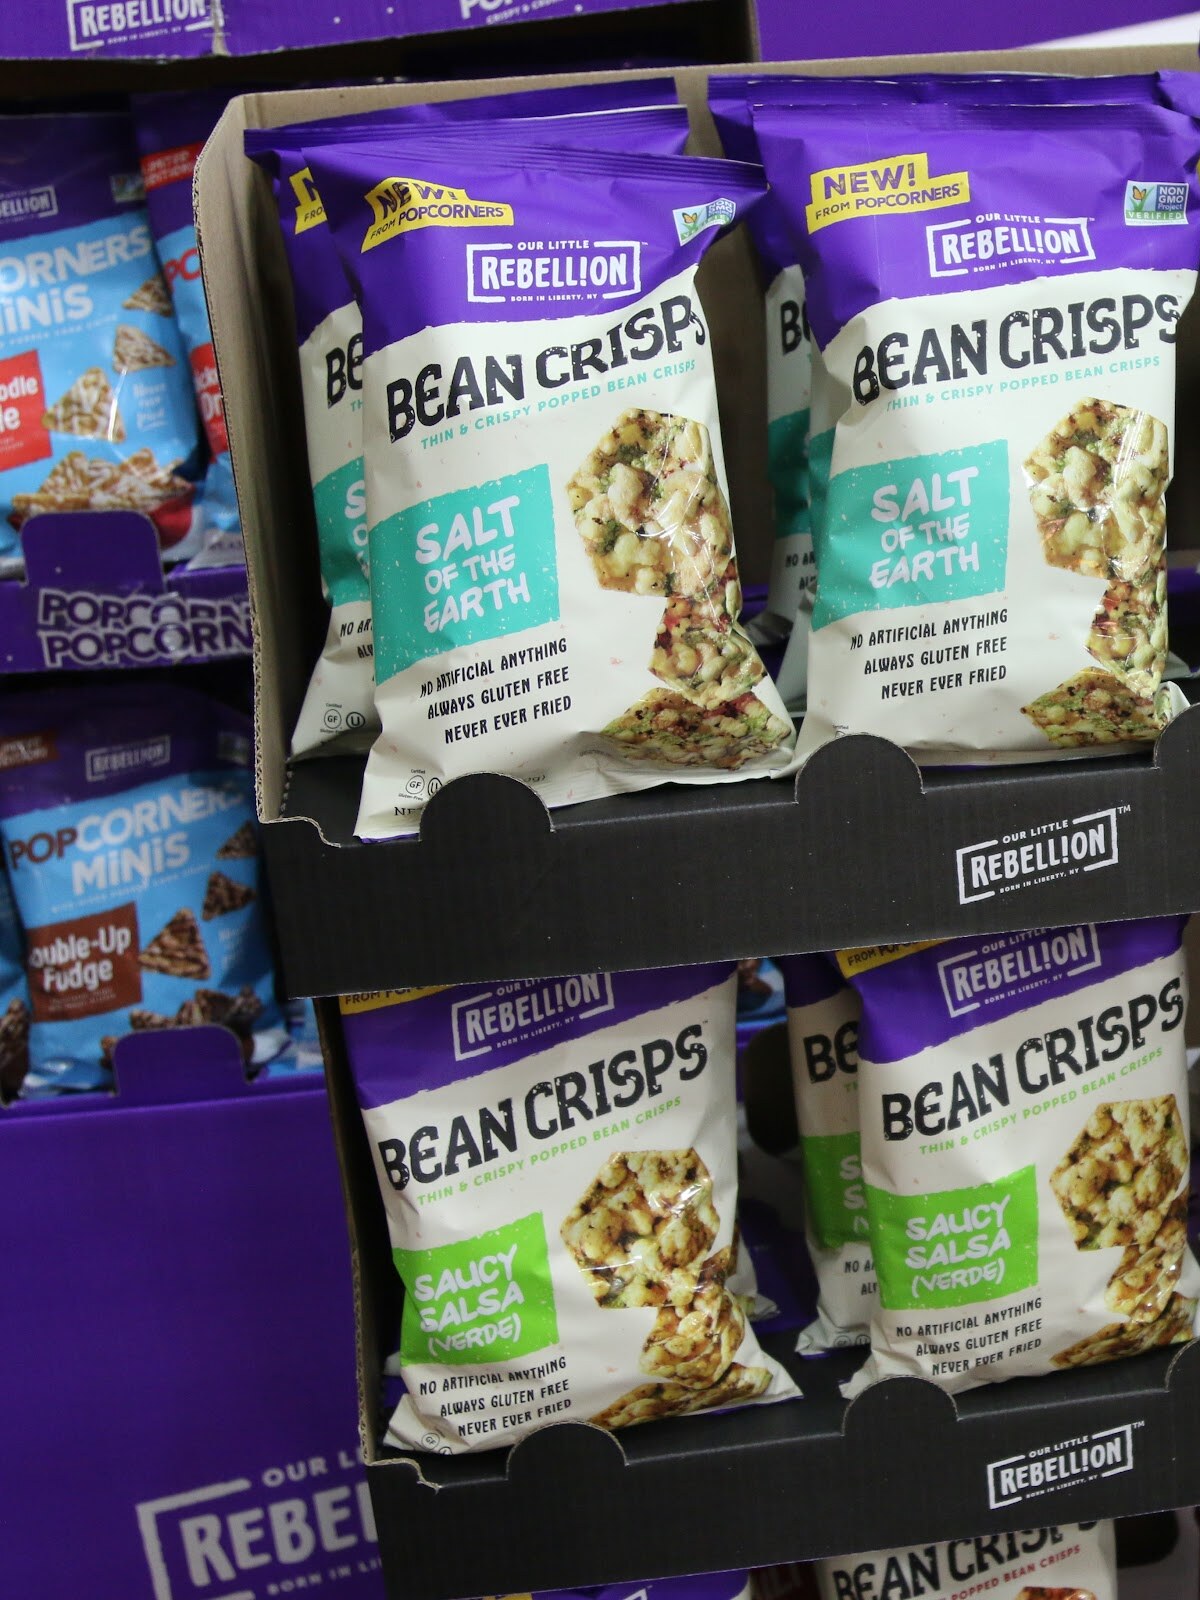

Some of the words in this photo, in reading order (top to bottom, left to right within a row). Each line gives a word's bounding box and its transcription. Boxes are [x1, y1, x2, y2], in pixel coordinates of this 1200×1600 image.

[376, 181, 457, 219] NEW!
[823, 163, 915, 199] NEW!
[1158, 187, 1185, 196] NON
[1158, 195, 1184, 204] GMO
[398, 202, 504, 226] POPCORNERS
[816, 202, 850, 220] FROM
[855, 184, 960, 210] POPCORNERS
[1128, 211, 1183, 220] VERIFIED
[1158, 203, 1182, 211] Project
[0, 227, 150, 289] ORNERS
[517, 241, 544, 250] OUR
[548, 240, 590, 250] LITTLE
[974, 264, 995, 273] BORN
[387, 353, 524, 443] BEAN
[536, 295, 706, 389] CRISPS
[853, 319, 987, 406] BEAN
[1000, 295, 1181, 370] CRISPS
[871, 466, 979, 522] SALT
[415, 495, 520, 564] SALT
[880, 525, 914, 552] OF
[919, 514, 970, 542] THE
[424, 566, 459, 595] OF
[463, 544, 518, 581] THE
[869, 542, 979, 589] EARTH
[423, 572, 530, 633] EARTH
[869, 622, 937, 645] ARTIFICIAL
[943, 609, 1008, 635] ANYTHING
[436, 661, 496, 693] ARTIFICIAL
[500, 638, 568, 669] ANYTHING
[864, 652, 914, 675] ALWAYS
[920, 645, 969, 666] GLUTEN
[976, 637, 1007, 655] FREE
[428, 695, 474, 720] ALWAYS
[481, 679, 530, 704] GLUTEN
[537, 667, 569, 688] FREE
[881, 681, 924, 700] NEVER
[930, 673, 963, 691] EVER
[969, 665, 1007, 686] FRIED
[444, 722, 488, 744] NEVER
[494, 710, 528, 731] EVER
[534, 696, 572, 719] FRIED
[410, 781, 421, 789] GF
[1003, 831, 1026, 844] OUR
[1031, 819, 1068, 837] LITTLE
[1000, 884, 1020, 894] BORN
[1034, 872, 1066, 885] LIBERTY,
[29, 927, 131, 966] ouble-Up
[44, 958, 113, 992] Fudge
[881, 1053, 1010, 1141] BEAN
[1015, 976, 1185, 1096] CRISPS
[378, 1097, 519, 1191] BEAN
[524, 1024, 708, 1140] CRISPS
[974, 1113, 1018, 1141] CRISPY
[1023, 1090, 1077, 1120] POPPED
[1081, 1071, 1116, 1094] BEAN
[1120, 1047, 1163, 1077] CRISPS
[474, 1159, 525, 1189] CRISPY
[530, 1135, 587, 1166] POPPED
[593, 1119, 630, 1142] BEAN
[635, 1096, 681, 1126] CRISPS
[906, 1194, 1010, 1241] SAUCY
[905, 1228, 1010, 1271] SALSA
[414, 1243, 518, 1302] SAUCY
[911, 1259, 1005, 1298] (VERDE)
[419, 1285, 524, 1333] SALSA
[917, 1315, 979, 1336] ARTIFICIAL
[984, 1297, 1042, 1325] ANYTHING
[428, 1313, 521, 1357] (VERDE)
[916, 1340, 960, 1357] ALWAYS
[965, 1329, 1009, 1350] GLUTEN
[1015, 1318, 1042, 1336] FREE
[442, 1372, 504, 1392] ARTIFICIAL
[508, 1356, 566, 1382] ANYTHING
[932, 1359, 969, 1376] NEVER
[1009, 1338, 1041, 1358] FRIED
[440, 1397, 485, 1418] ALWAYS
[491, 1387, 535, 1409] GLUTEN
[541, 1378, 569, 1399] FREE
[458, 1417, 496, 1438] NEVER
[502, 1409, 532, 1429] EVER
[538, 1397, 572, 1418] FRIED
[1029, 1446, 1050, 1458] OUR
[1054, 1436, 1089, 1452] LITTLE
[262, 1456, 327, 1488] OUR
[180, 1485, 378, 1587] REBE
[1003, 1563, 1036, 1582] BEAN
[1040, 1545, 1081, 1569] CRISPS
